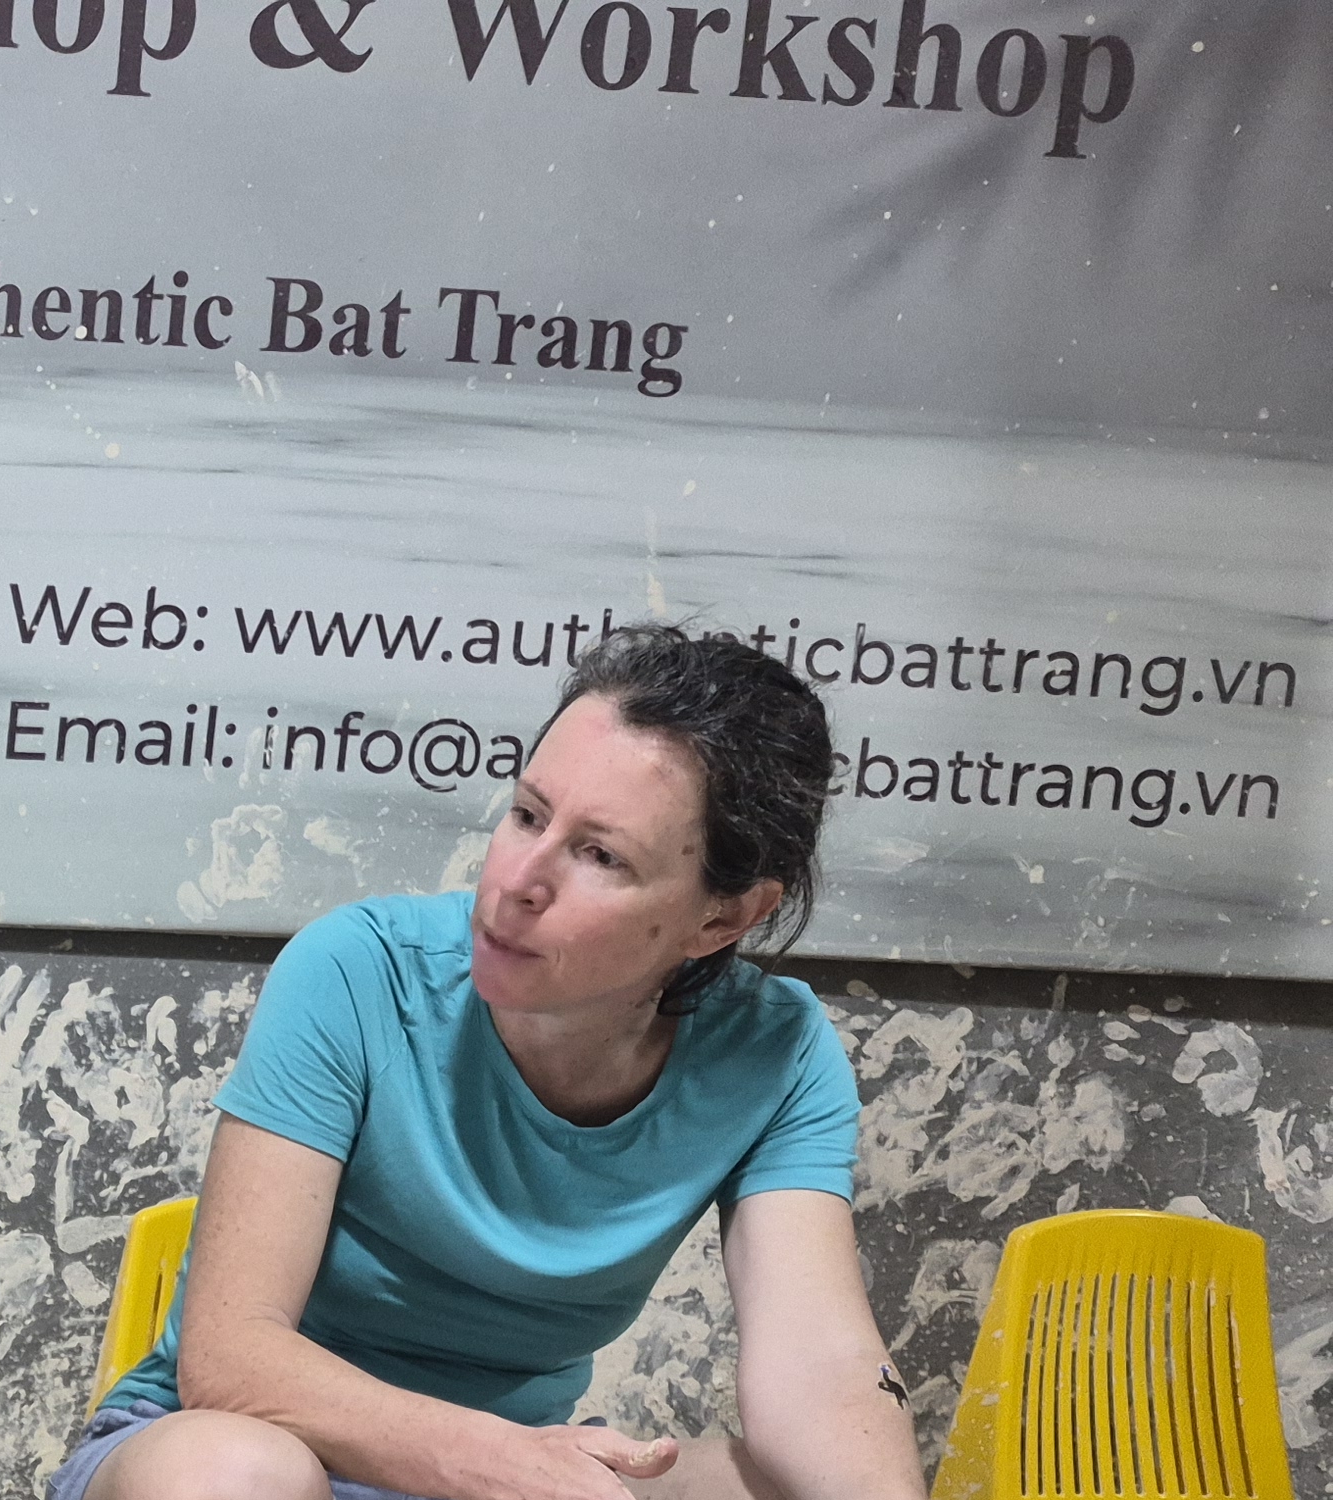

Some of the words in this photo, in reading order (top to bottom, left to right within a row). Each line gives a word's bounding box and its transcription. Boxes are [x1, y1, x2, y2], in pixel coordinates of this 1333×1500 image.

[249, 0, 377, 73] &
[447, 0, 1136, 160] Workshop
[259, 276, 413, 360] Bat
[438, 286, 689, 398] Trang
[9, 582, 211, 652] Web:
[234, 606, 1297, 718] www.autticbattrang.vn
[5, 700, 237, 769] Email:
[261, 706, 1281, 829] info@abattrang.vn
